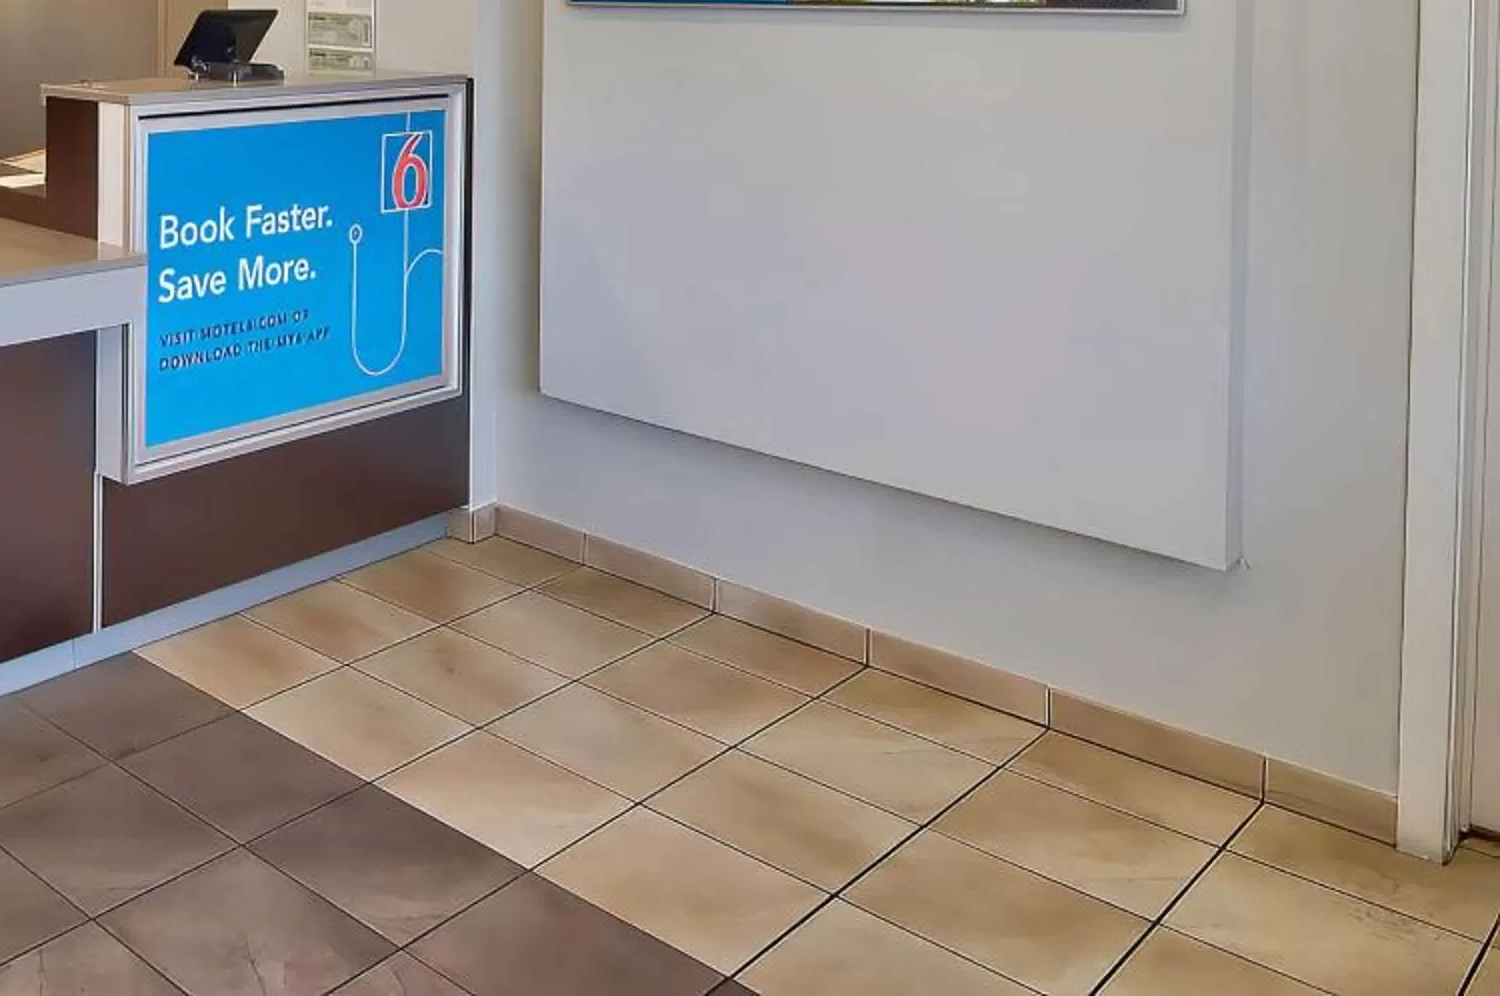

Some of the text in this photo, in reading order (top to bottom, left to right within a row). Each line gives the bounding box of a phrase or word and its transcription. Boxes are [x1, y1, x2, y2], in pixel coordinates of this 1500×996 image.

[392, 132, 430, 211] 6
[160, 203, 333, 250] Book Faster.
[158, 255, 317, 303] Save More.
[159, 343, 242, 372] DOWNLOAD
[160, 329, 195, 347] VISIT
